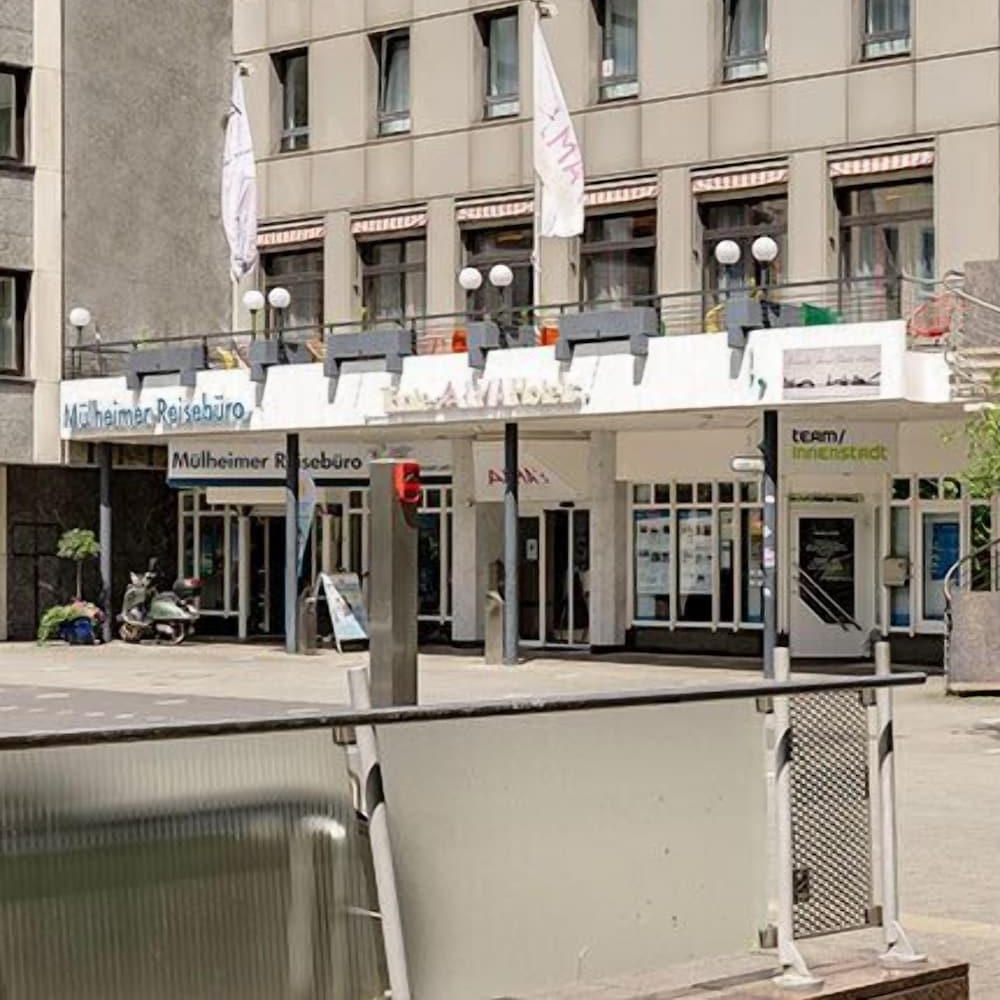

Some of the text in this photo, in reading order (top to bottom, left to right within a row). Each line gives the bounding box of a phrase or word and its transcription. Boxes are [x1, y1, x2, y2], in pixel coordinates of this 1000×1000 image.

[64, 392, 245, 429] Mülheimer Reisebüro
[171, 451, 363, 470] Mülheimer Rsebüro
